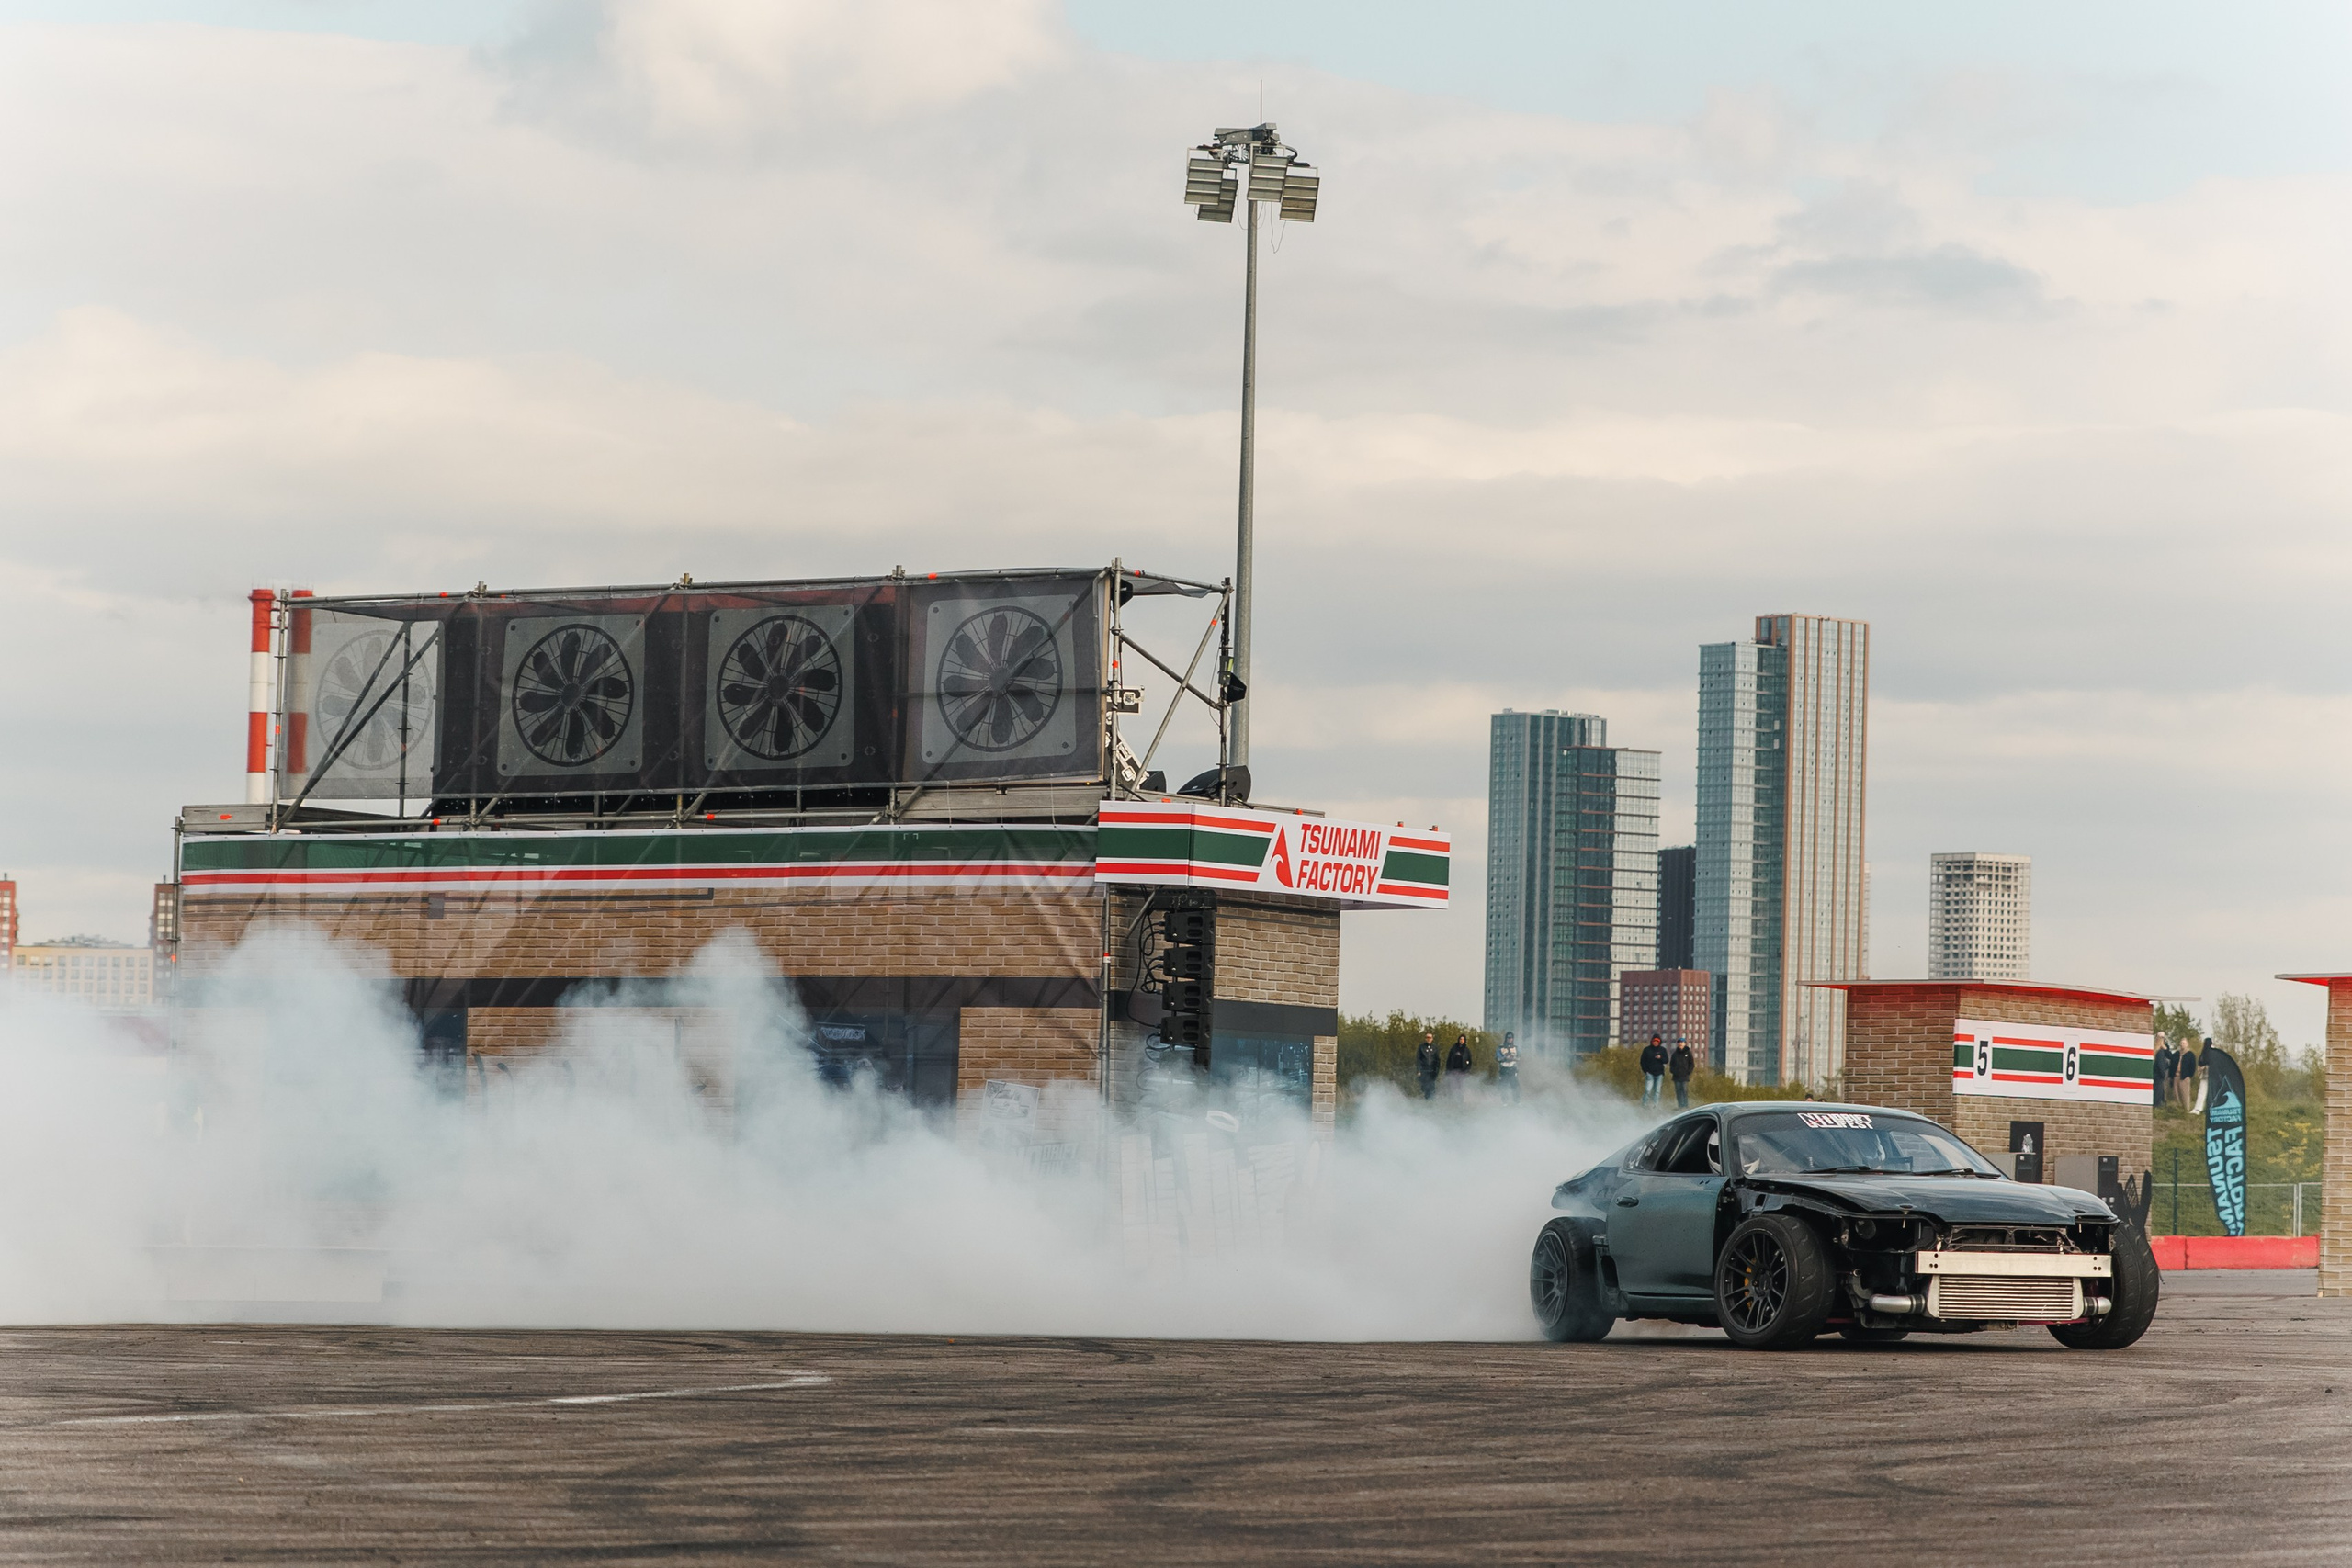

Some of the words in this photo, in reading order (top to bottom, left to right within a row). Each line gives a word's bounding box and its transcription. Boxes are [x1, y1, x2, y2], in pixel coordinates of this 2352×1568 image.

[1300, 823, 1382, 861] TSUNAMI
[1296, 860, 1379, 895] FACTORY
[1977, 1041, 1988, 1076] 5
[2066, 1047, 2076, 1081] 6
[1840, 1119, 1874, 1130] FEST
